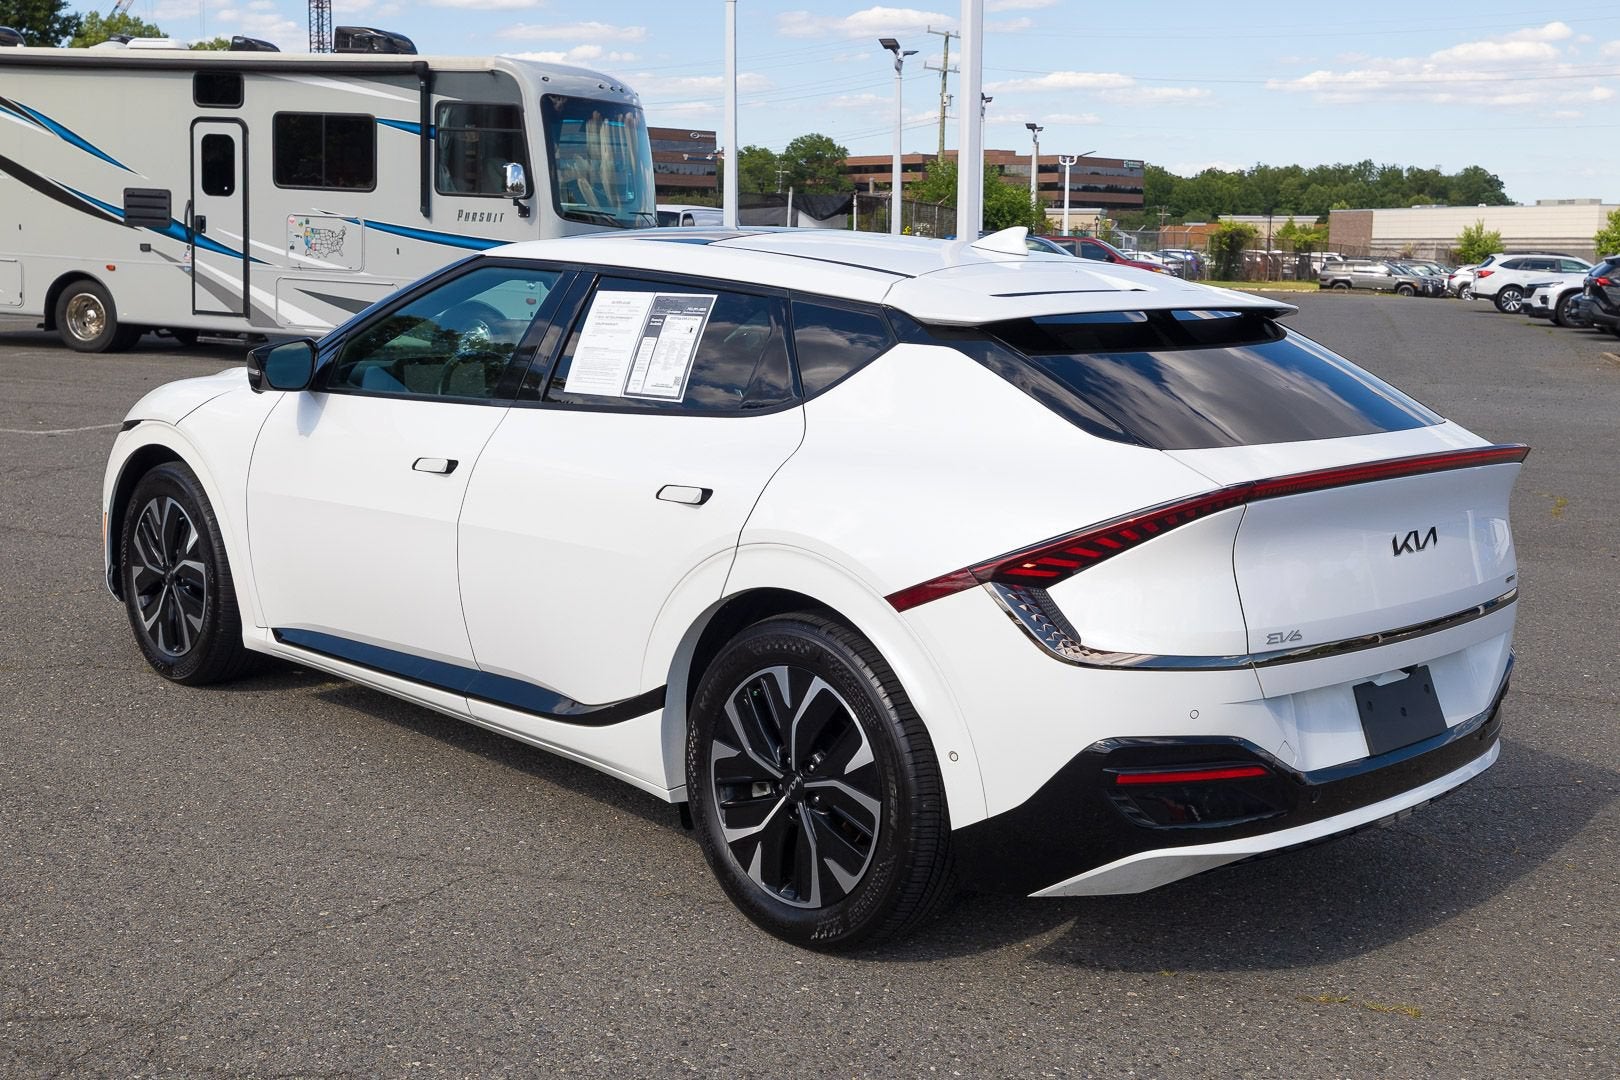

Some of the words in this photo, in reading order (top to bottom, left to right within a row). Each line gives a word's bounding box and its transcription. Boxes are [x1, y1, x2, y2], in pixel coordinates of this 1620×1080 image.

[456, 209, 505, 223] PURSUIT
[1391, 526, 1438, 557] KIA
[1266, 629, 1303, 645] EV6
